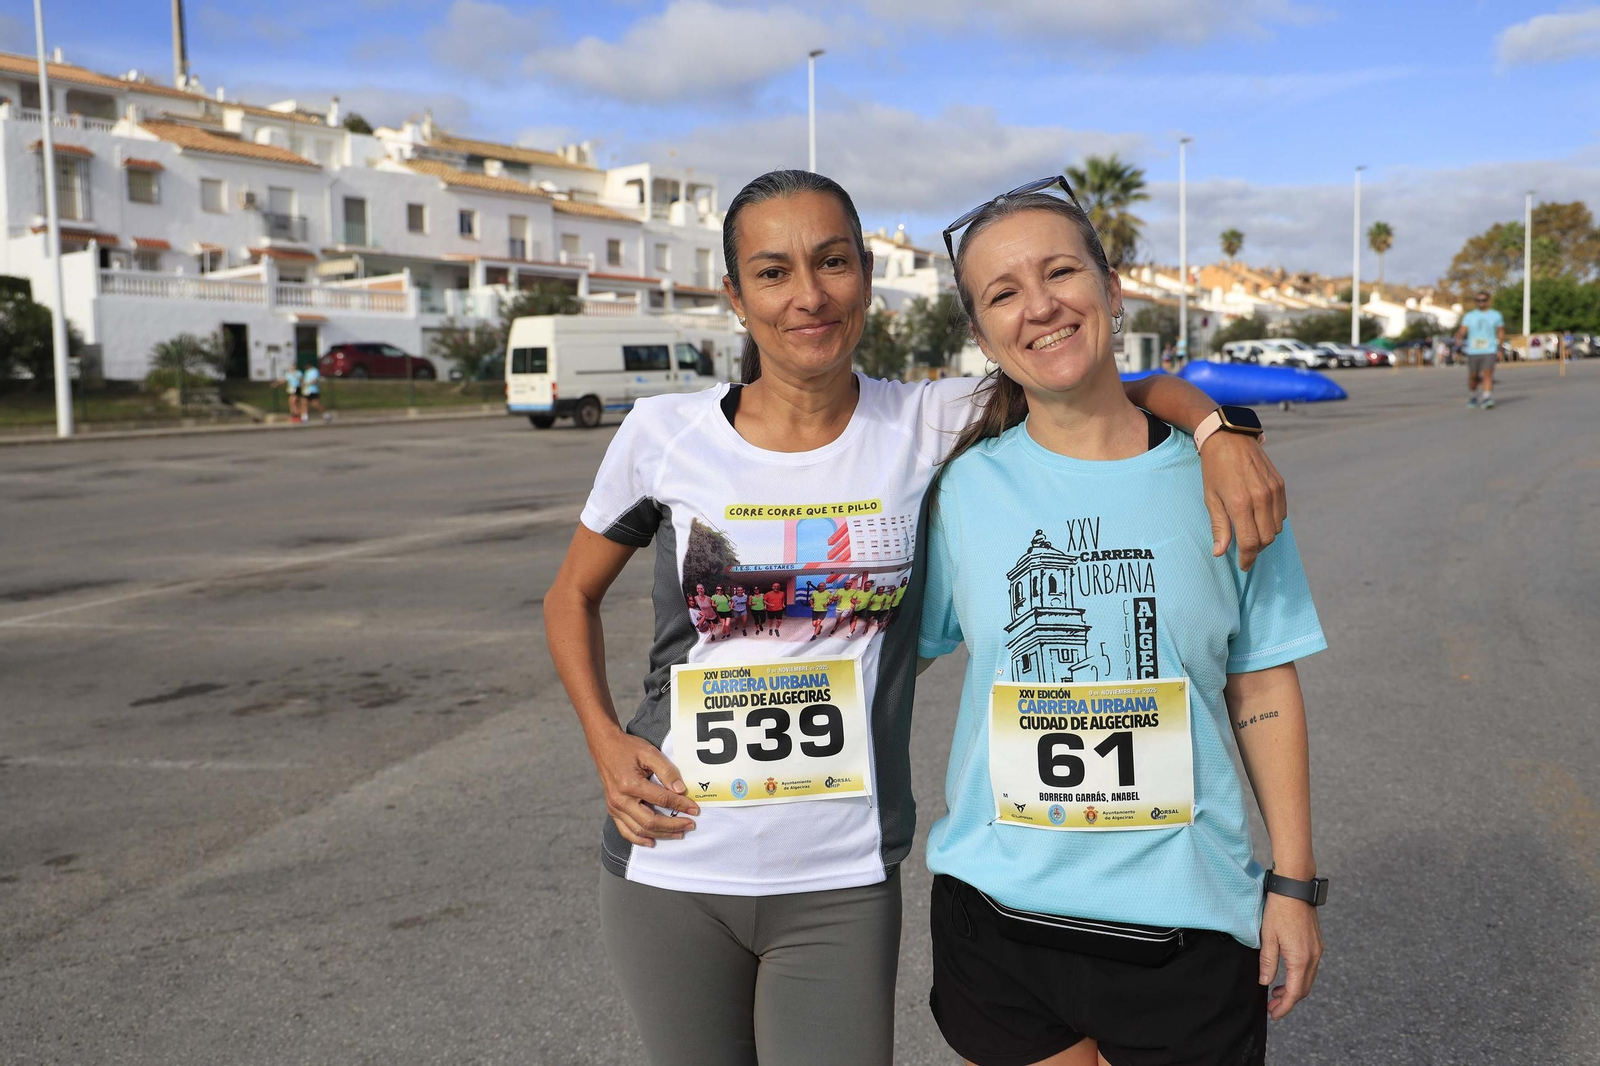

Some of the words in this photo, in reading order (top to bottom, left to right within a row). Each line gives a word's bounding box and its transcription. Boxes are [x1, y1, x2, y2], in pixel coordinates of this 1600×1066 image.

[729, 507, 764, 517] CORRE
[767, 507, 802, 517] CORRE
[806, 506, 828, 516] QUE
[831, 505, 844, 514] TE
[847, 501, 878, 513] PILLO
[1066, 516, 1100, 552] XXV
[1080, 549, 1155, 562] CARRERA
[1077, 561, 1156, 597] URBANA
[703, 671, 719, 681] XXV
[720, 667, 751, 679] EDICIÓN
[702, 677, 768, 695] CARRERA
[769, 672, 830, 691] URBANA
[1101, 688, 1135, 696] NOVIEMBRE
[704, 694, 749, 710] CIUDAD
[750, 692, 767, 707] DE
[768, 688, 831, 706] ALGECIRAS
[1019, 689, 1035, 699] XXV
[1037, 688, 1071, 699] EDICIÓN
[1017, 699, 1089, 715] CARRERA
[1091, 696, 1158, 714] URBANA
[1019, 715, 1068, 730] CIUDAD
[1070, 717, 1088, 730] DE
[1089, 713, 1159, 730] ALGECIRAS
[1249, 715, 1258, 724] et
[696, 704, 845, 765] 539
[1037, 731, 1136, 788] 61
[1039, 792, 1074, 802] BORRERO
[1075, 790, 1109, 803] GARRÁS,
[1111, 791, 1141, 801] ANABEL
